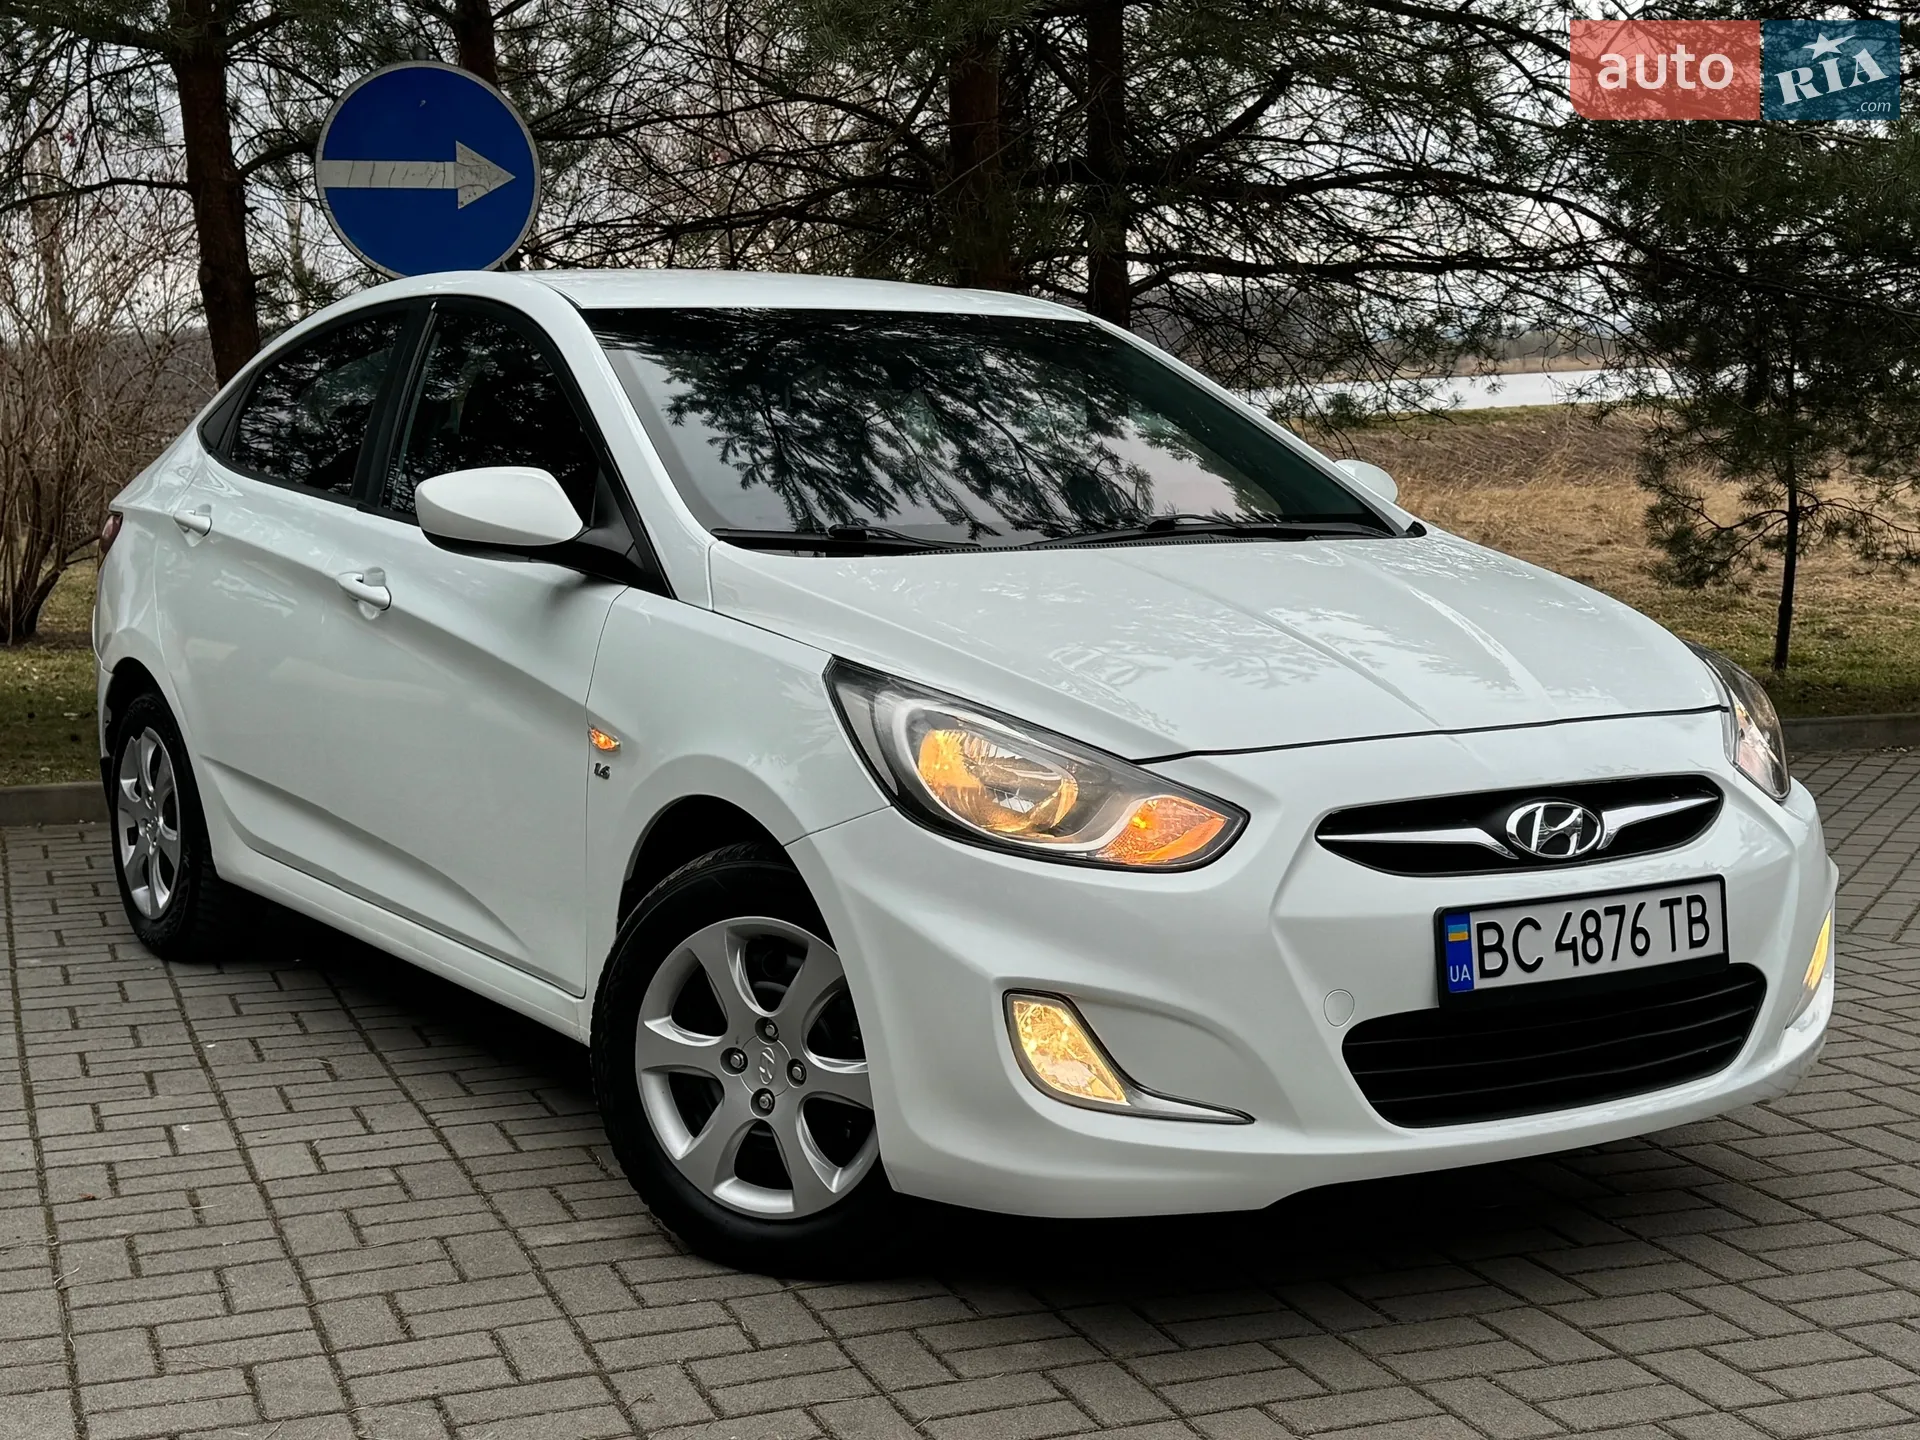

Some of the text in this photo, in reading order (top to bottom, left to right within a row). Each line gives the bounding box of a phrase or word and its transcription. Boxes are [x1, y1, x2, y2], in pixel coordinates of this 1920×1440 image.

[1475, 894, 1710, 979] BC 4876 TB
[1450, 964, 1471, 983] UA
